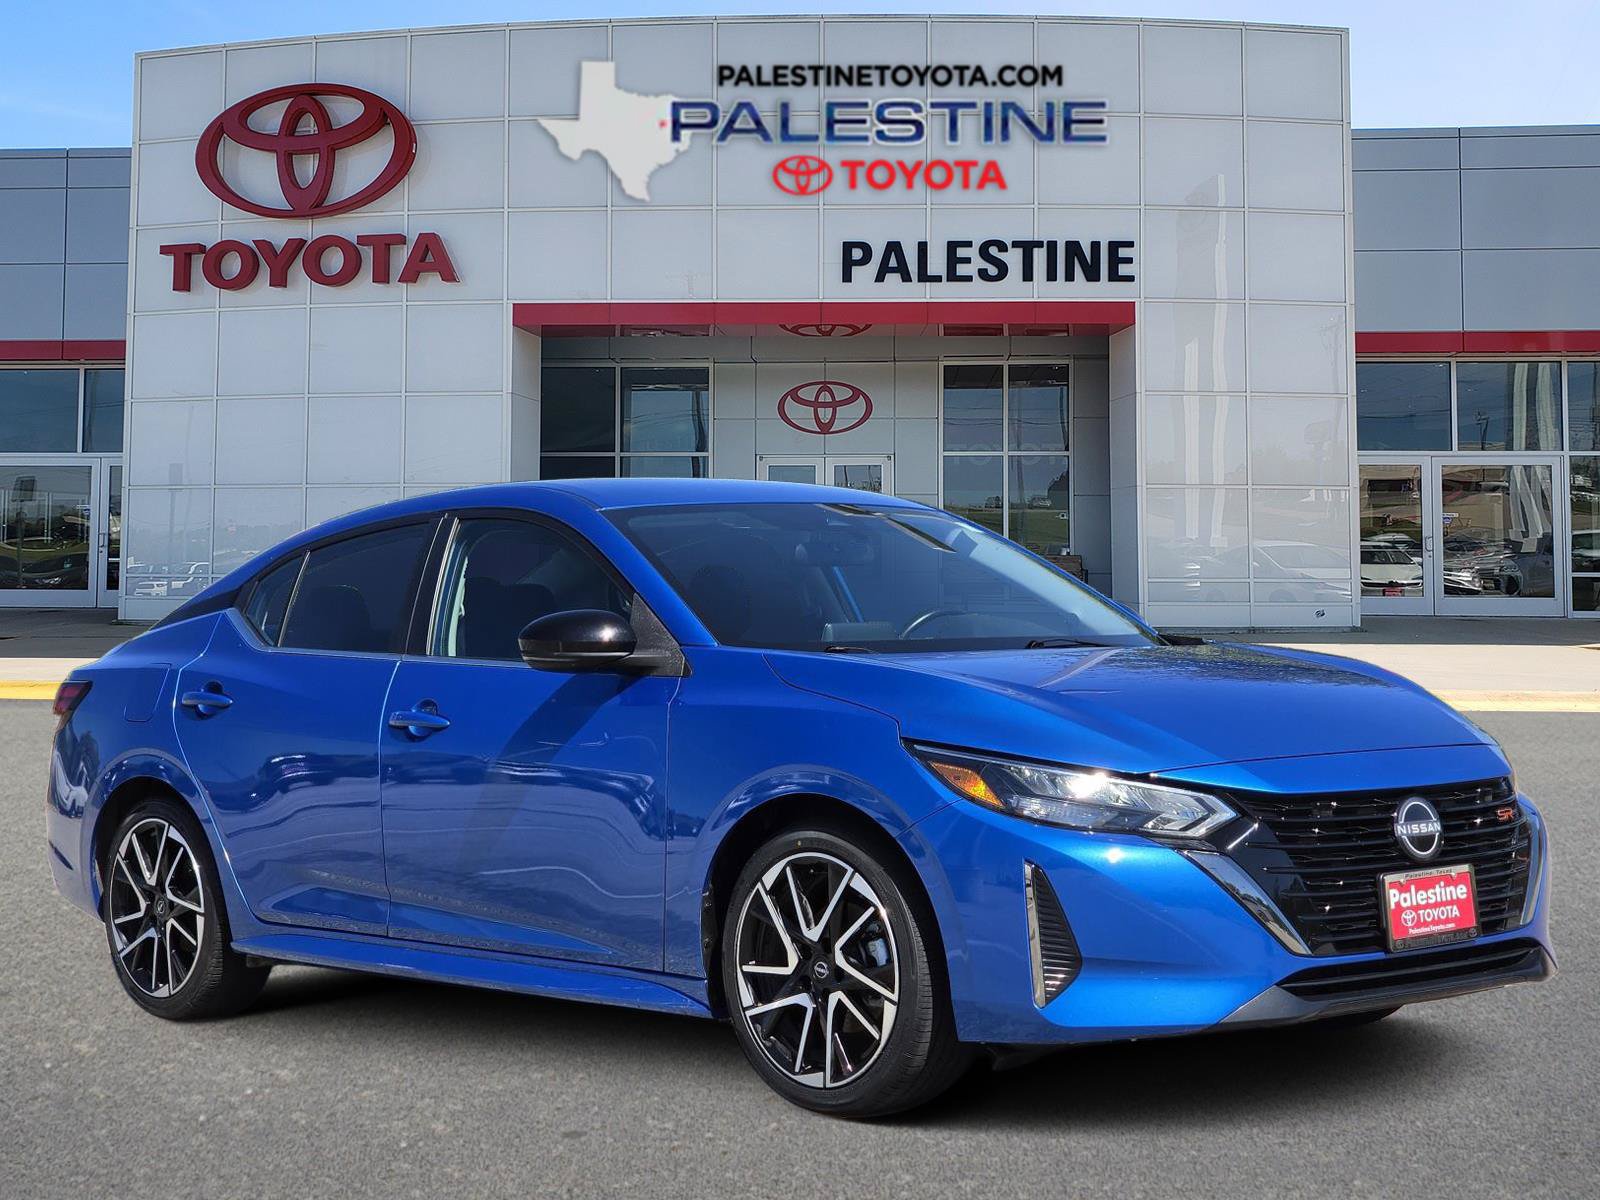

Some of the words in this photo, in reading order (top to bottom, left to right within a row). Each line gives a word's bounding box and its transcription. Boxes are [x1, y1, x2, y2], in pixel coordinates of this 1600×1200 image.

[160, 233, 459, 292] TOYOTA
[842, 240, 1135, 283] PALESTINE
[1397, 822, 1441, 835] NISSAN
[1389, 881, 1468, 910] Palestine
[1418, 905, 1460, 923] TOYOTA
